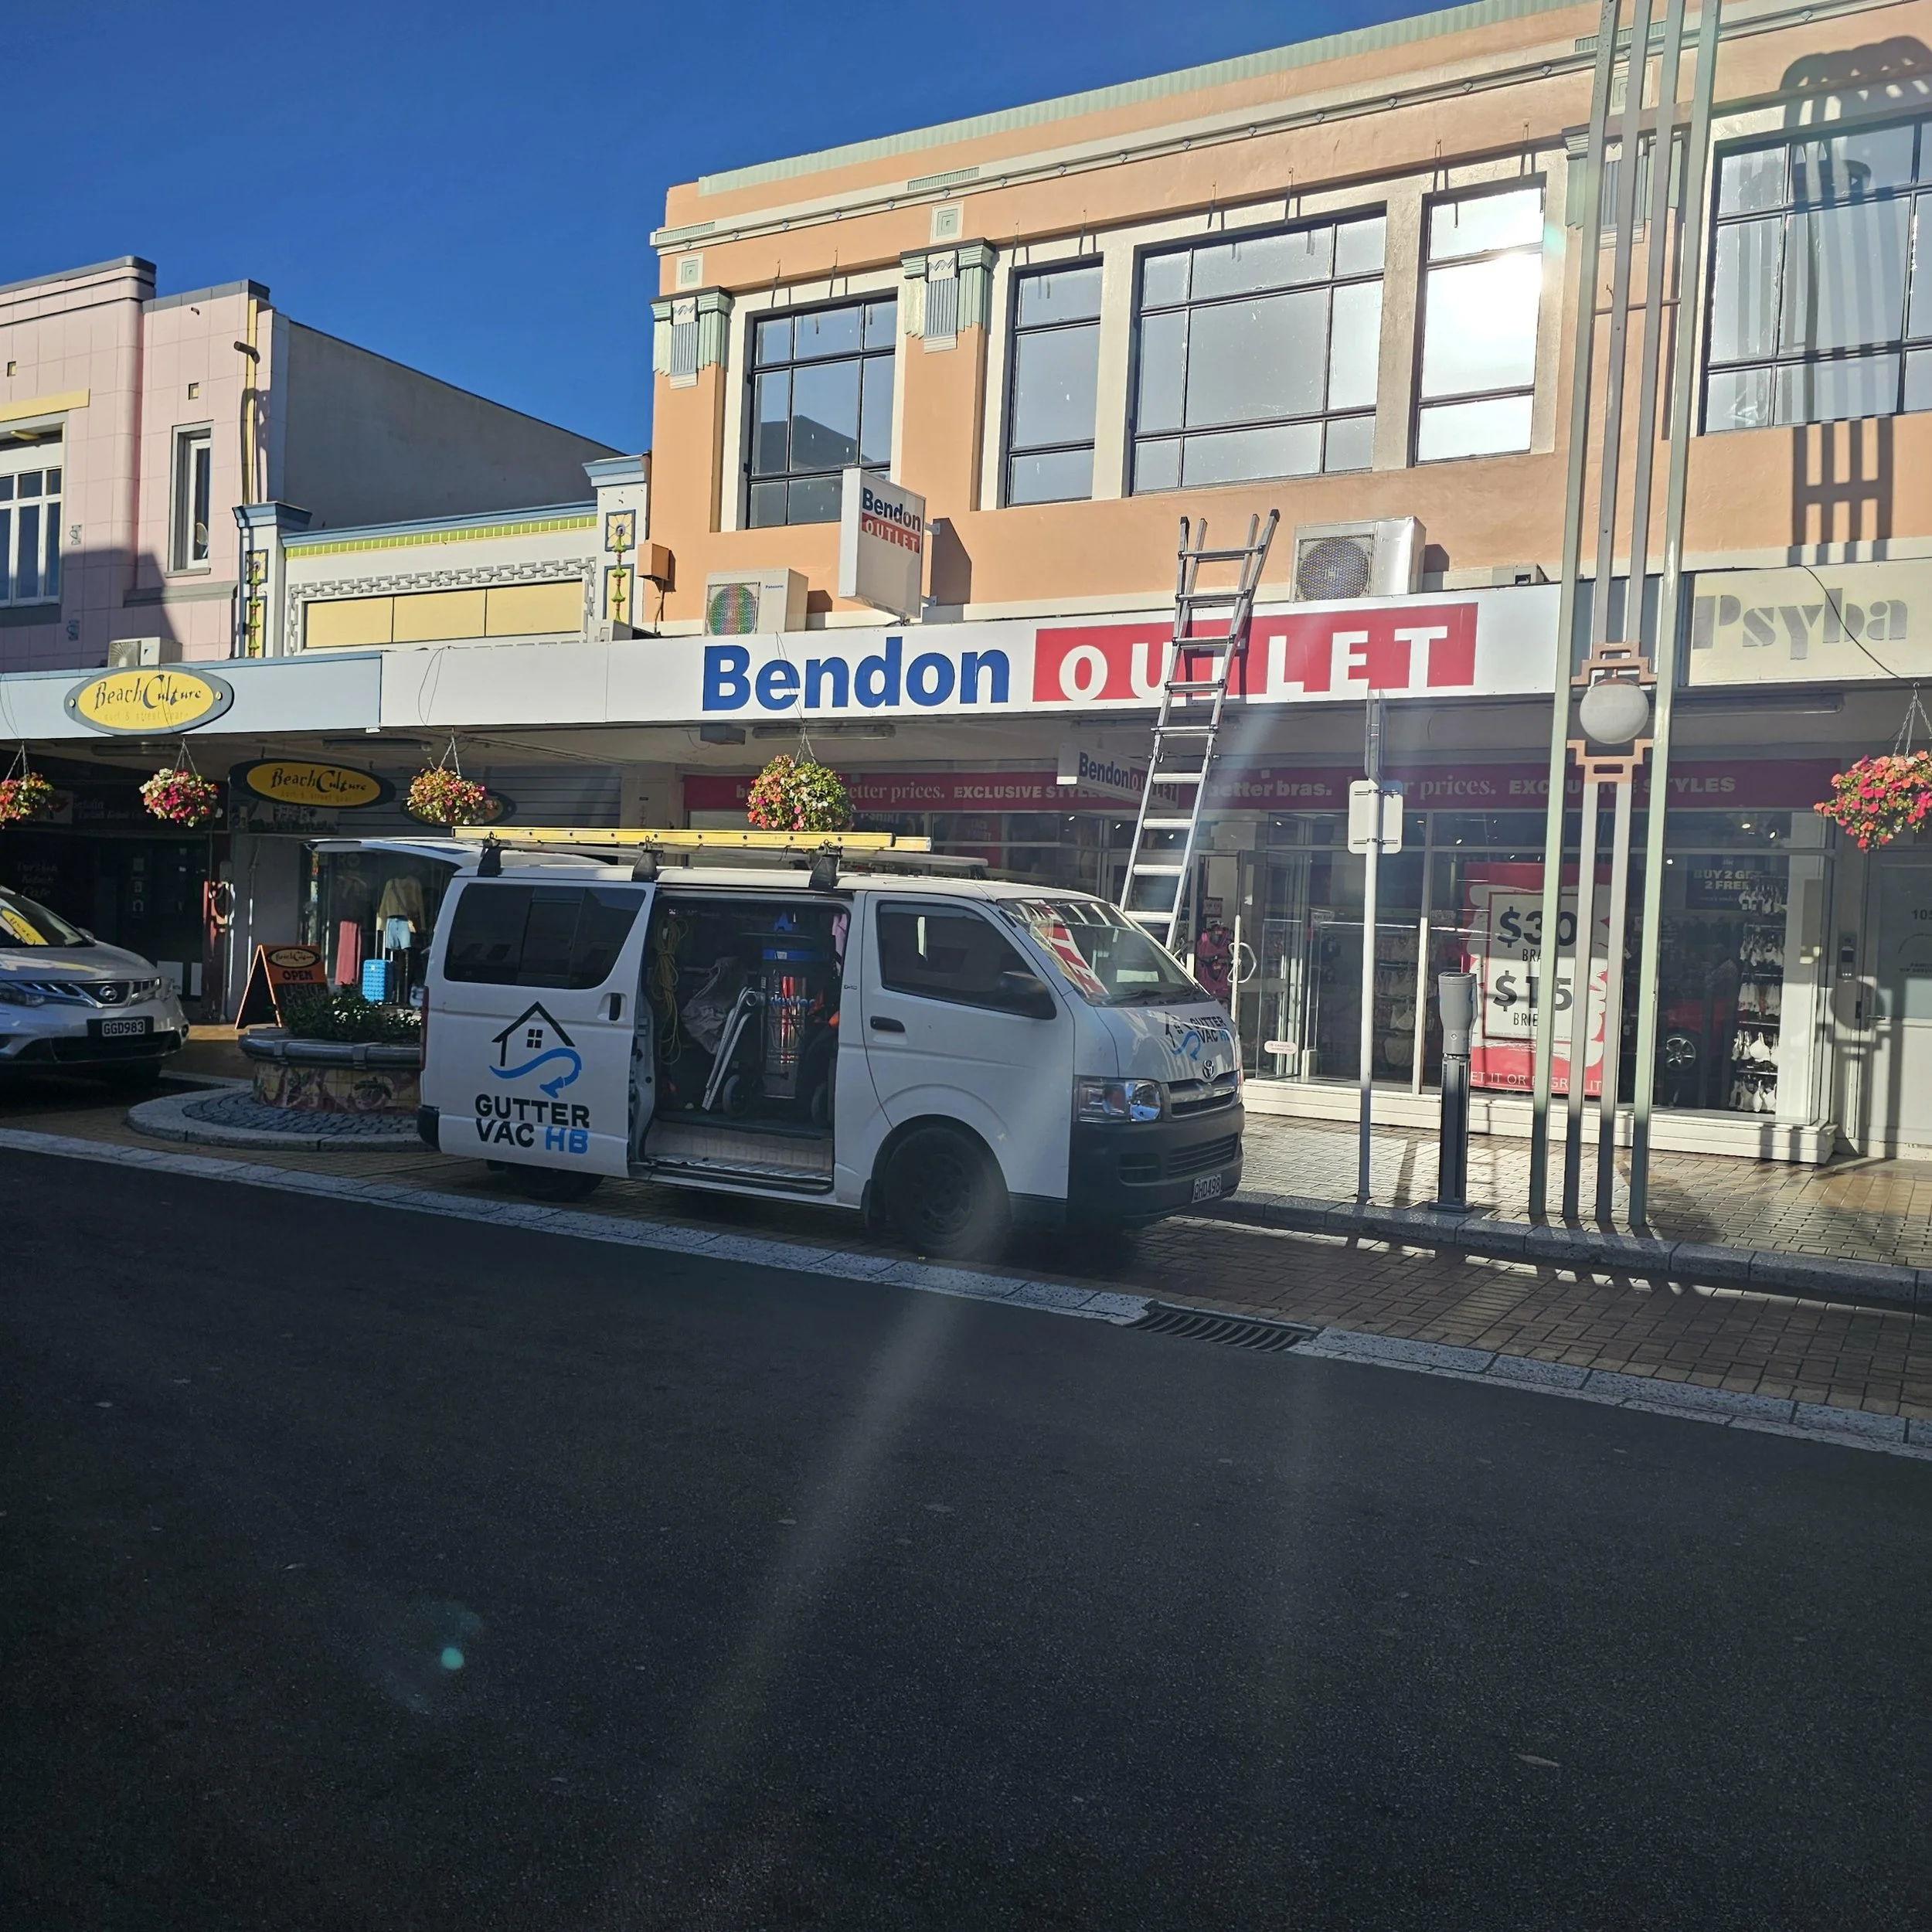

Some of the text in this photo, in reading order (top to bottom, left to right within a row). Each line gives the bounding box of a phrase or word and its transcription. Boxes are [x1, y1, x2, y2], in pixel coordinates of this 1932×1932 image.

[862, 487, 921, 532] Bendon
[866, 519, 918, 552] OUTLET
[1692, 587, 1908, 661] Psyba
[702, 636, 1010, 711] Bendon
[1078, 751, 1129, 789] Bendon
[849, 783, 887, 799] etter
[890, 781, 945, 803] prices.
[953, 785, 1043, 799] EXCLUSIVE
[1276, 780, 1332, 797] bras.
[1418, 774, 1497, 801] prices.
[1704, 880, 1713, 889] 2
[1724, 869, 1733, 879] 2
[1497, 906, 1578, 948] $30
[1522, 948, 1542, 962] BRA
[282, 969, 314, 981] OPEN
[1493, 970, 1573, 1012] $15
[104, 1021, 145, 1035] GGD983
[1513, 1012, 1539, 1027] BRIE
[1196, 1028, 1219, 1044] VAC
[1471, 1070, 1485, 1083] ET
[1491, 1073, 1503, 1083] IT
[1507, 1073, 1527, 1086] OR
[474, 1094, 590, 1129] GUTTER
[475, 1117, 589, 1155] VAC HB
